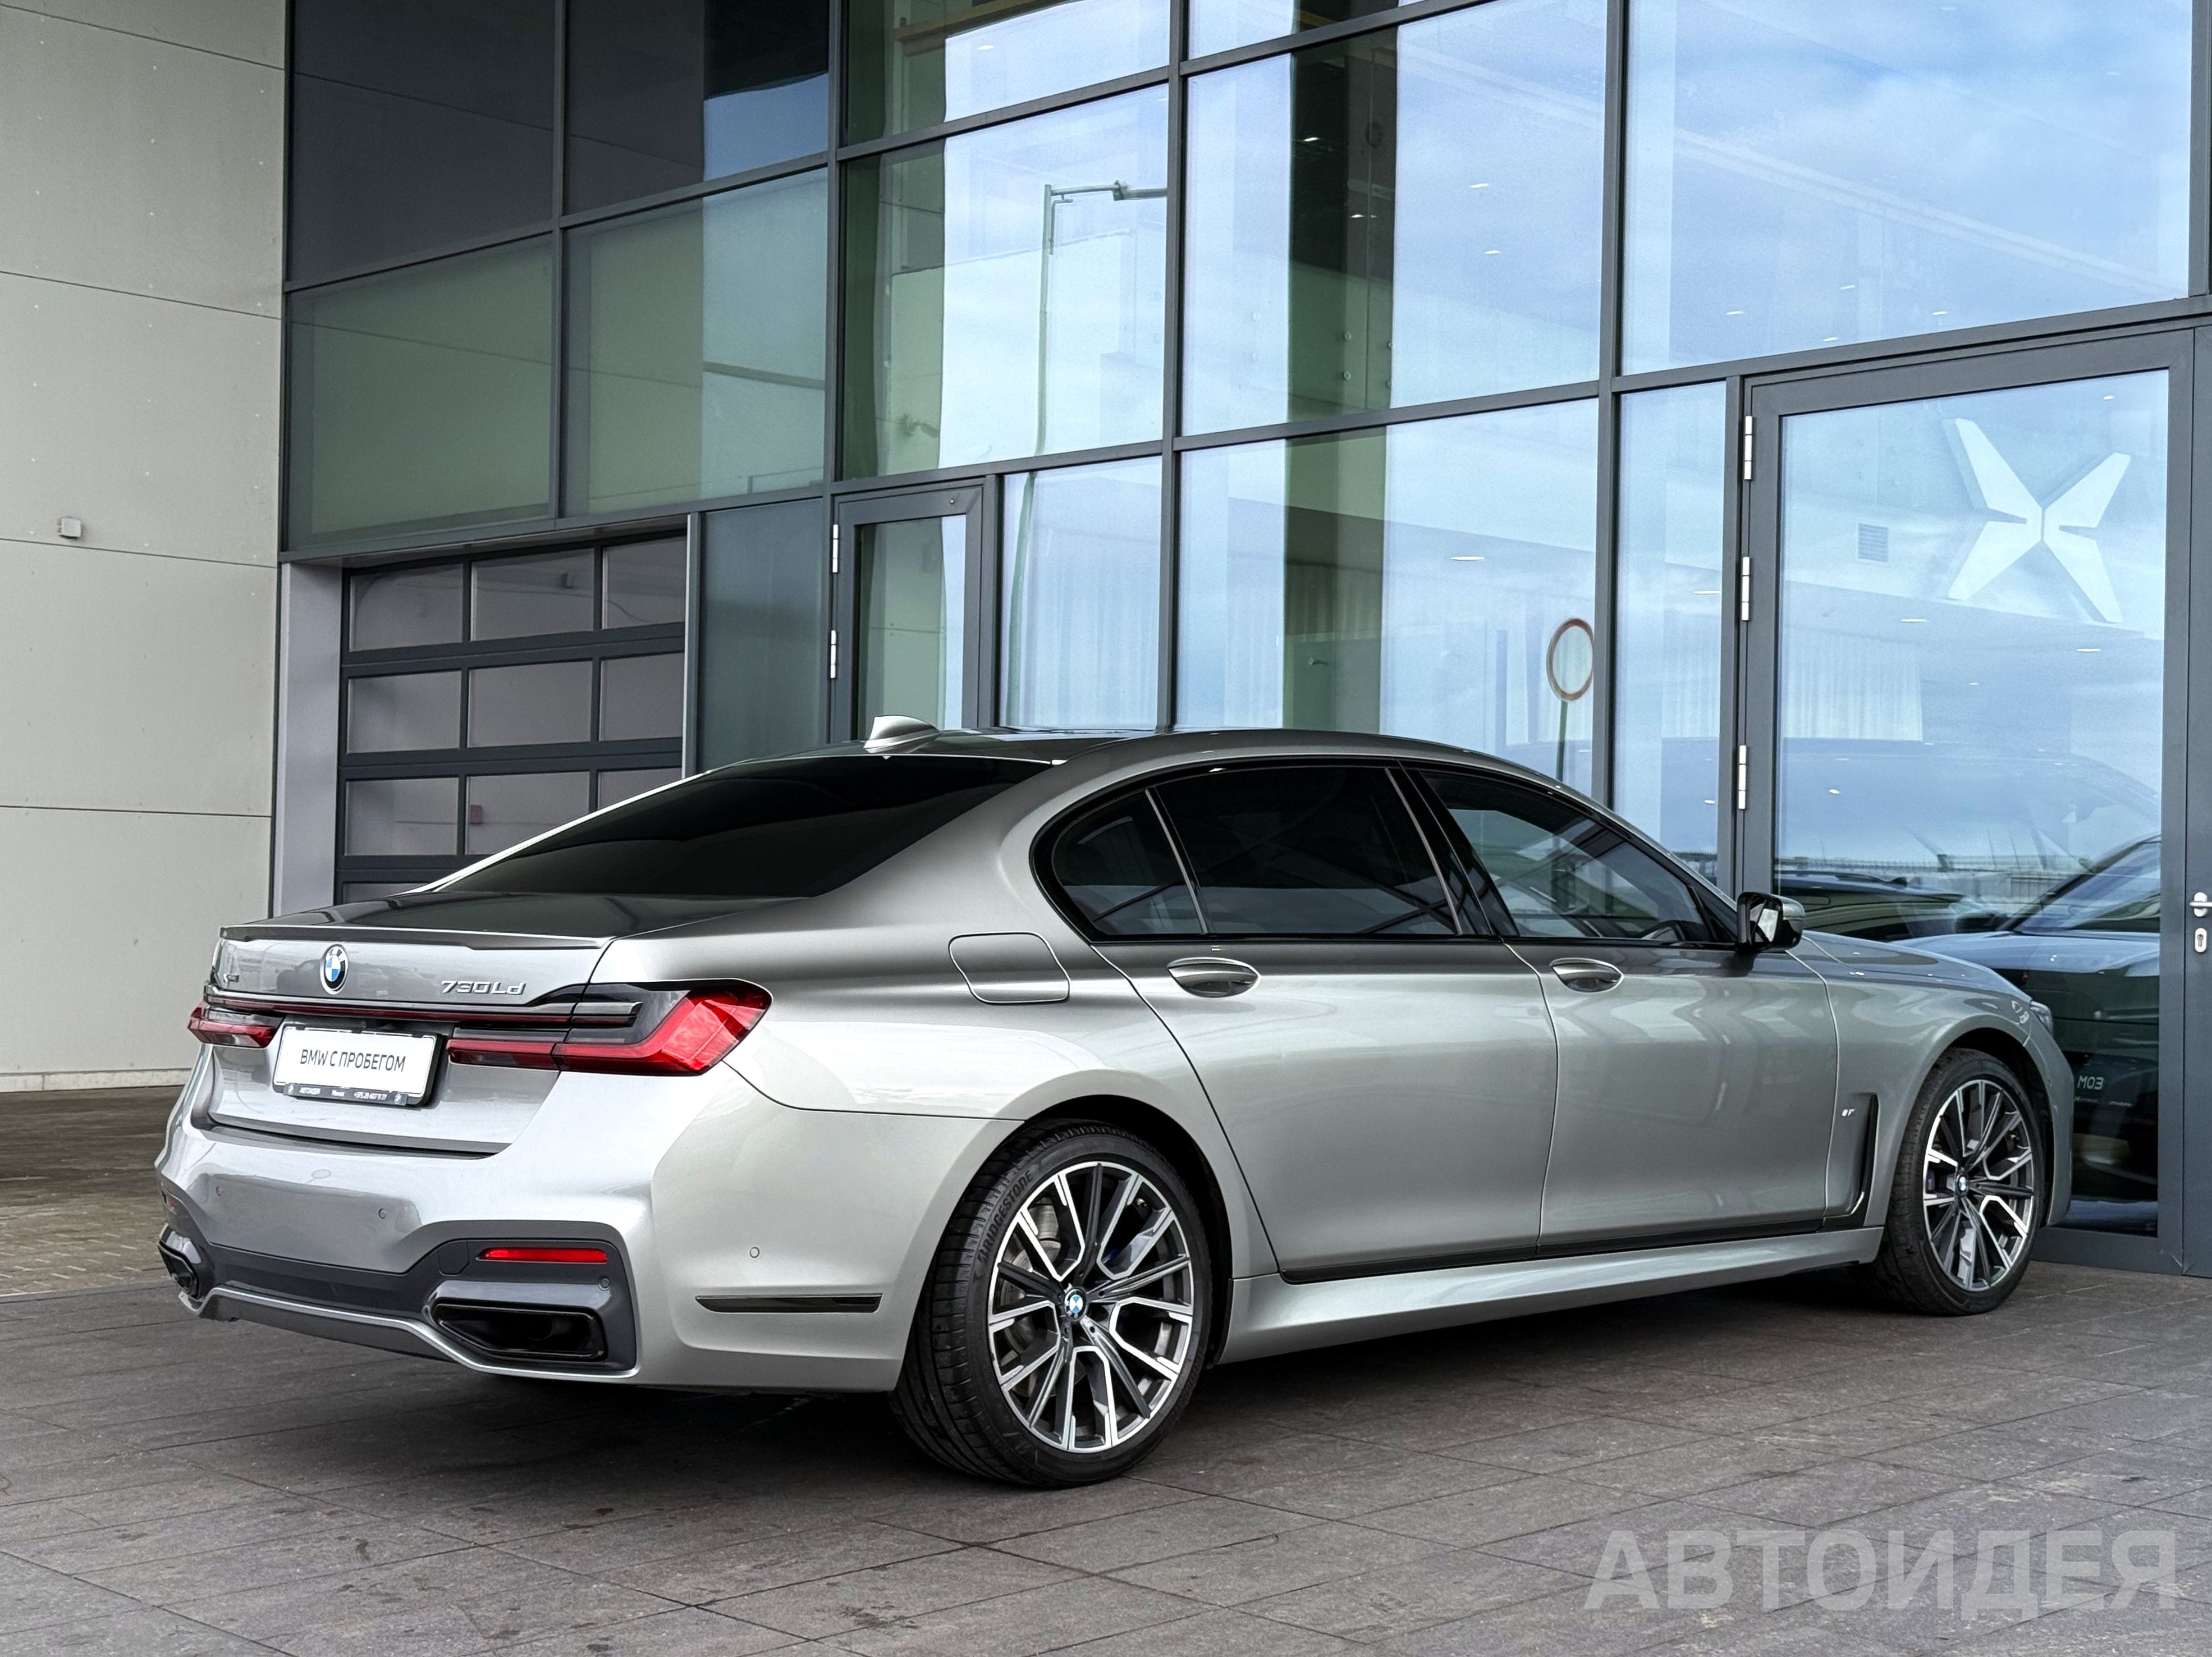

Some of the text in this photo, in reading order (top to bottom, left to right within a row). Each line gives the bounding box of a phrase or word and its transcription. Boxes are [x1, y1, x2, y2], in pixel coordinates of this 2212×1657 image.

[441, 980, 526, 995] 730Ld
[300, 1049, 406, 1072] BMW С ПРОБЕГОМ
[977, 1169, 1034, 1264] BRIDGESTONE
